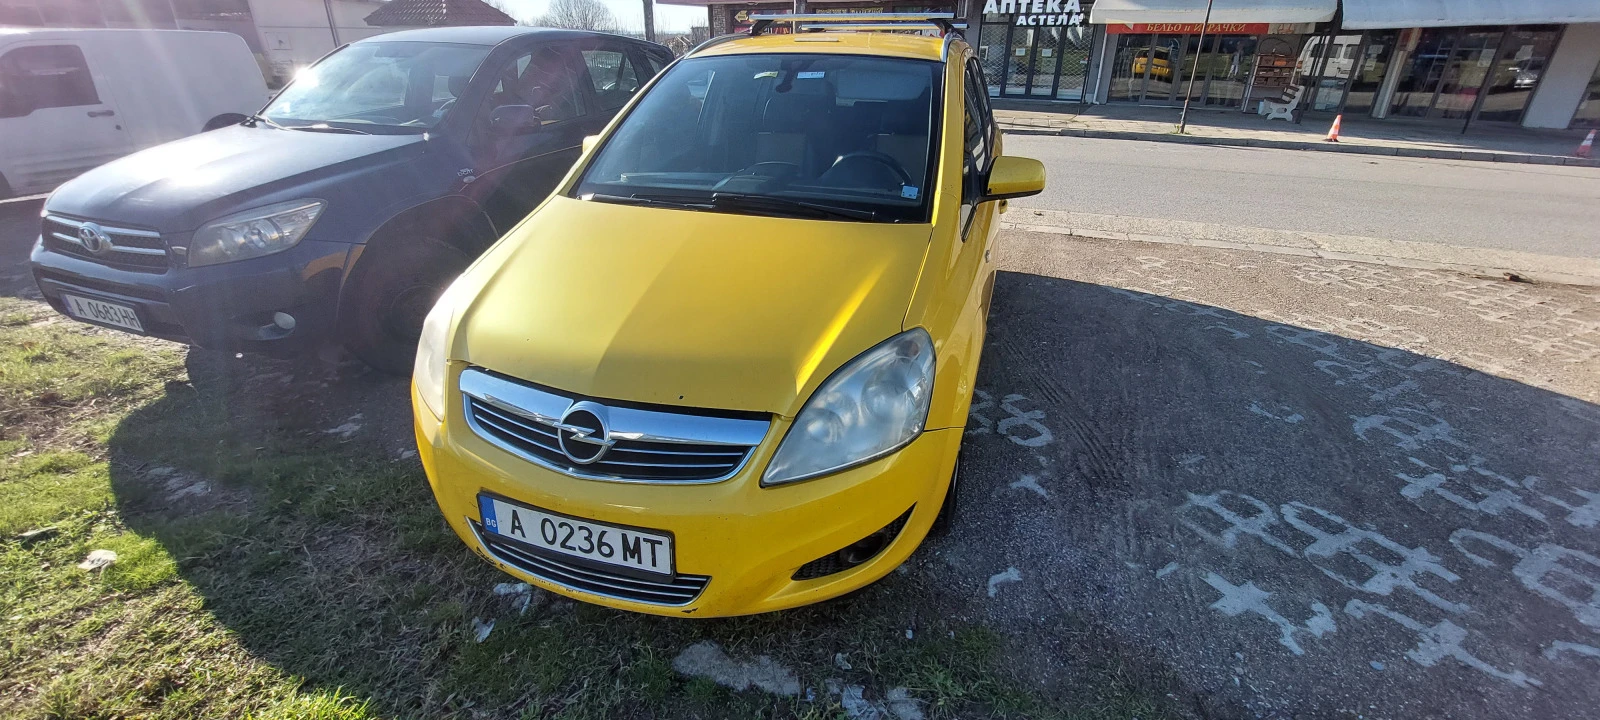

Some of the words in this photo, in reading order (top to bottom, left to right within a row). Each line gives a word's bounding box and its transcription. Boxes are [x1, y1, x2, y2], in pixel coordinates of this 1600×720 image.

[982, 0, 1081, 14] АПТЕКА
[1146, 23, 1182, 32] БЕЛЬО
[1193, 23, 1246, 32] ИРАЧКИ
[74, 298, 87, 316] A
[87, 301, 121, 324] 0683
[485, 517, 497, 528] BG
[510, 509, 527, 538] A
[540, 517, 615, 558] 0236
[621, 532, 663, 567] MT
